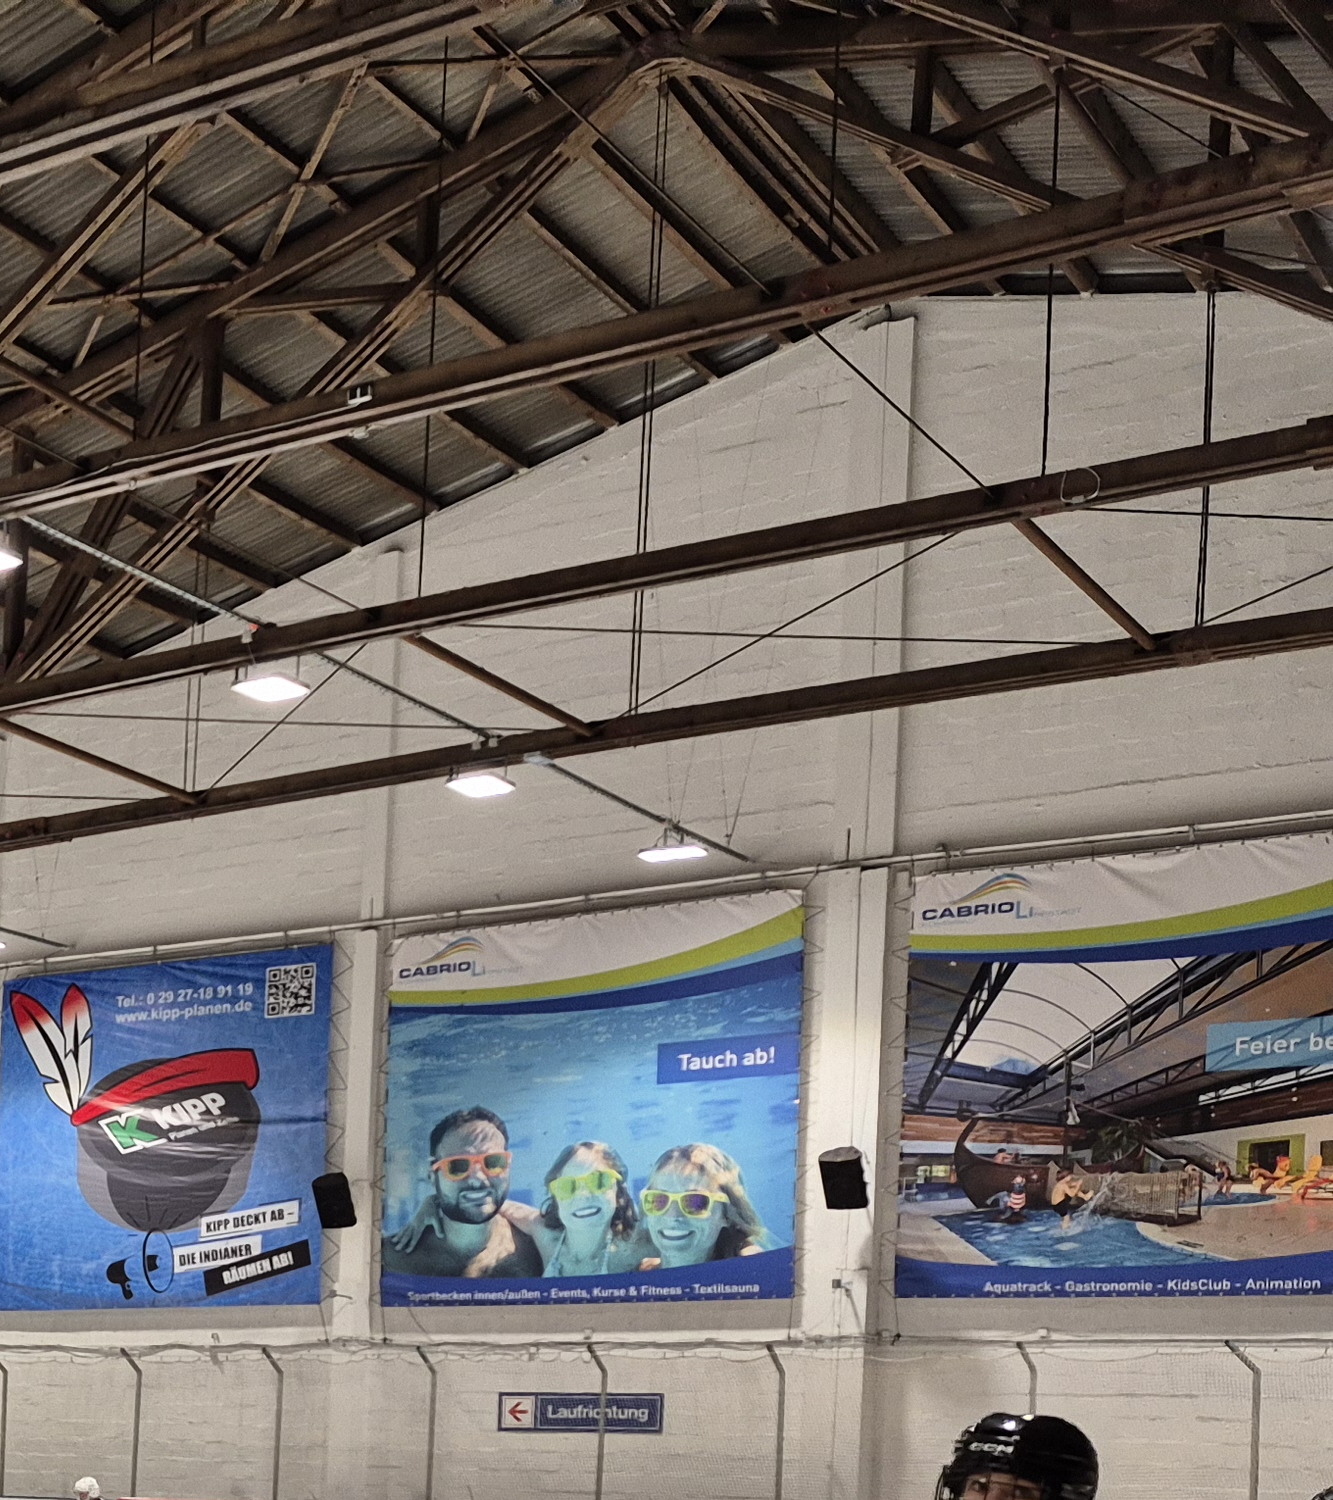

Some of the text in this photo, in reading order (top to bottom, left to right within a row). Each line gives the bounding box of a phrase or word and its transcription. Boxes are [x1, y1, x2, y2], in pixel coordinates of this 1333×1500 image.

[922, 902, 1014, 921] CABRIO
[399, 961, 471, 979] CABRIO
[146, 993, 155, 1005] 0
[158, 991, 174, 1004] 29
[177, 987, 214, 1002] 27-18
[217, 984, 232, 998] 91
[237, 982, 253, 996] 19
[115, 999, 253, 1024] www.kipp-planen.de
[1235, 1034, 1301, 1056] Feier
[678, 1046, 775, 1071] Tauch ab!
[151, 1092, 226, 1130] KIPP
[206, 1218, 230, 1233] KIPP
[233, 1211, 268, 1227] DECKT
[270, 1209, 284, 1221] AB
[179, 1243, 252, 1266] DIE INDIANER
[222, 1251, 294, 1285] RÄUMEN AB!
[593, 1286, 626, 1297] Kurse
[629, 1286, 637, 1296] &
[641, 1285, 682, 1296] Fitness
[692, 1283, 760, 1295] Textilsauna
[984, 1281, 1052, 1294] Aquatrack
[1065, 1280, 1153, 1292] Gastronomie
[1167, 1278, 1230, 1290] KidsClub
[1245, 1277, 1321, 1290] Animation
